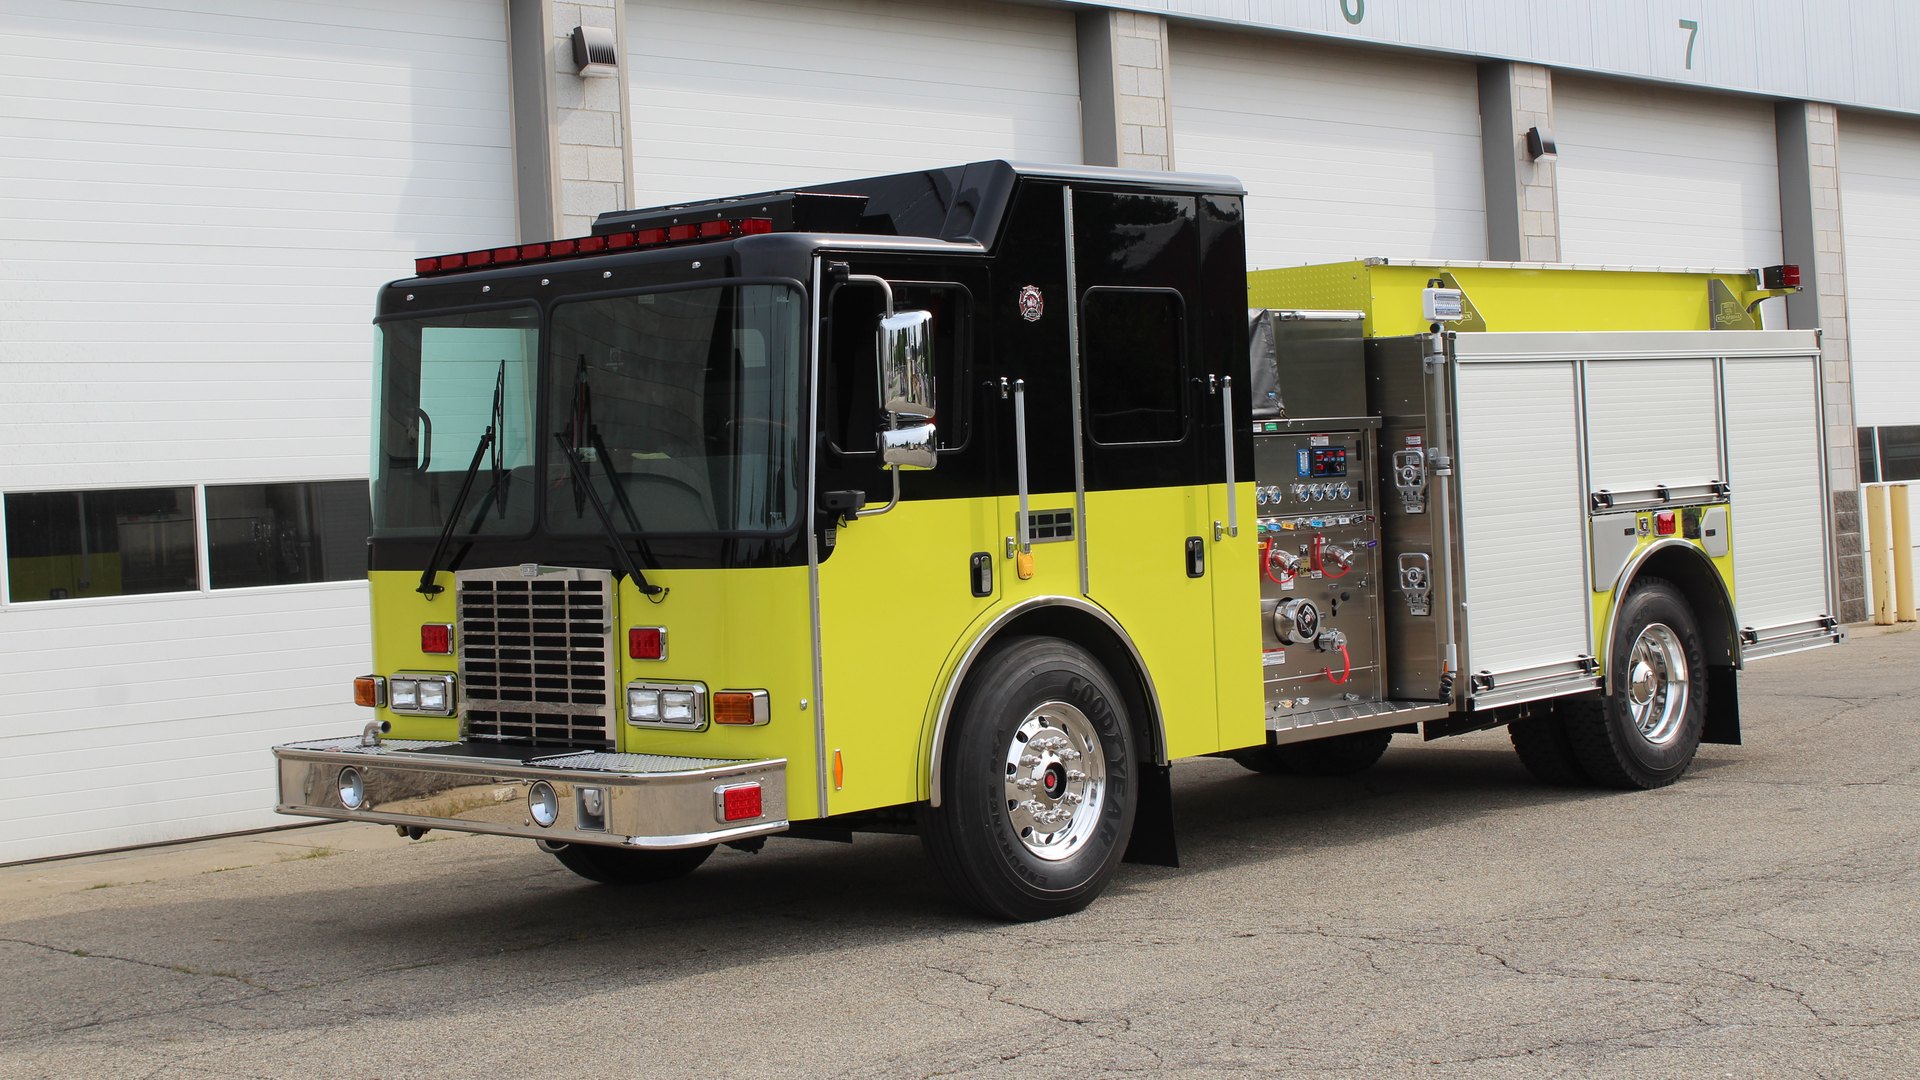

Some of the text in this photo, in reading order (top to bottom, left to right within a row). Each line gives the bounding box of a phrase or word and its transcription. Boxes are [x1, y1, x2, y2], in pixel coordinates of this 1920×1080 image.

[1678, 18, 1698, 70] 7
[1625, 604, 1649, 646] RSD
[1065, 675, 1127, 849] GOODYEAR
[1663, 632, 1704, 767] GOODYEAR
[988, 727, 1049, 888] ENDURANCE RSA
